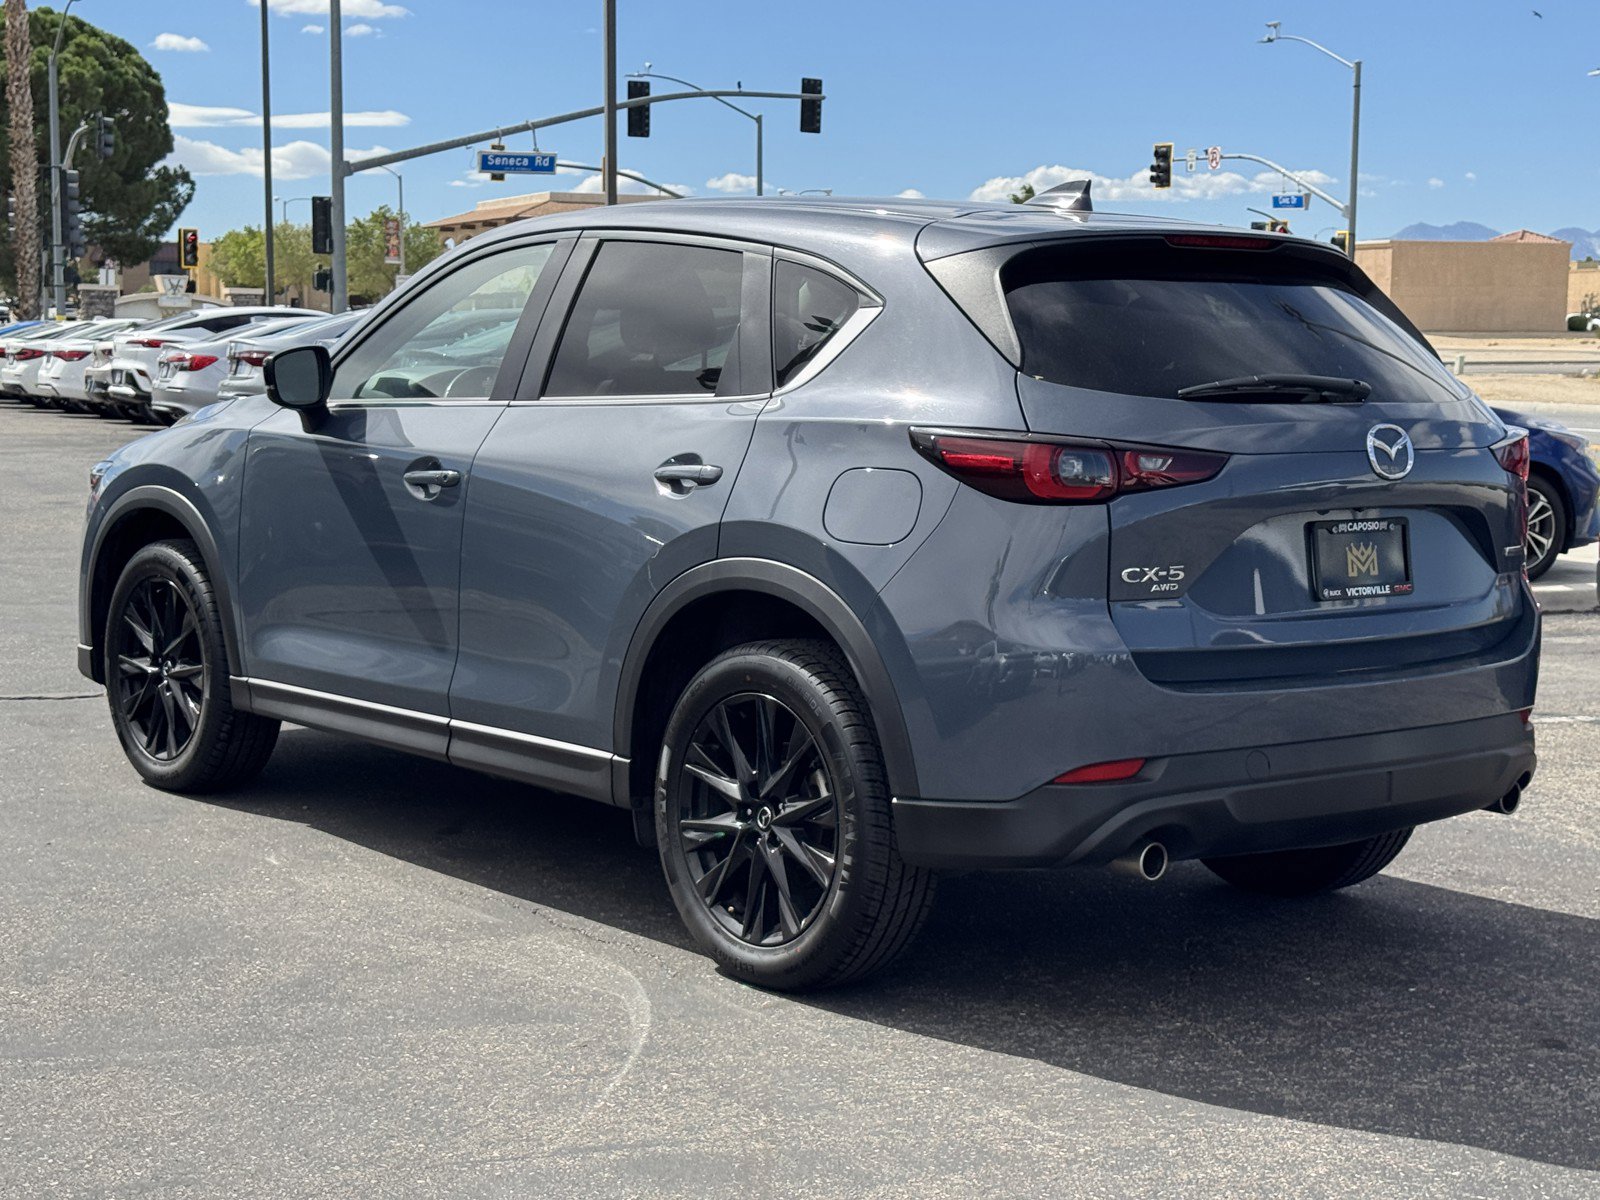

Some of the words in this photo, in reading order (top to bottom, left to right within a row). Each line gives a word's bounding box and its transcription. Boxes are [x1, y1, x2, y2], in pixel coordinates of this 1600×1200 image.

[488, 155, 528, 166] Seneca
[535, 156, 549, 166] Rd
[1347, 521, 1379, 531] CAPOSIO
[1121, 566, 1184, 582] CX-5
[1151, 583, 1178, 592] AWD
[1346, 585, 1390, 596] VICTORVILLE
[1393, 584, 1412, 592] GMC
